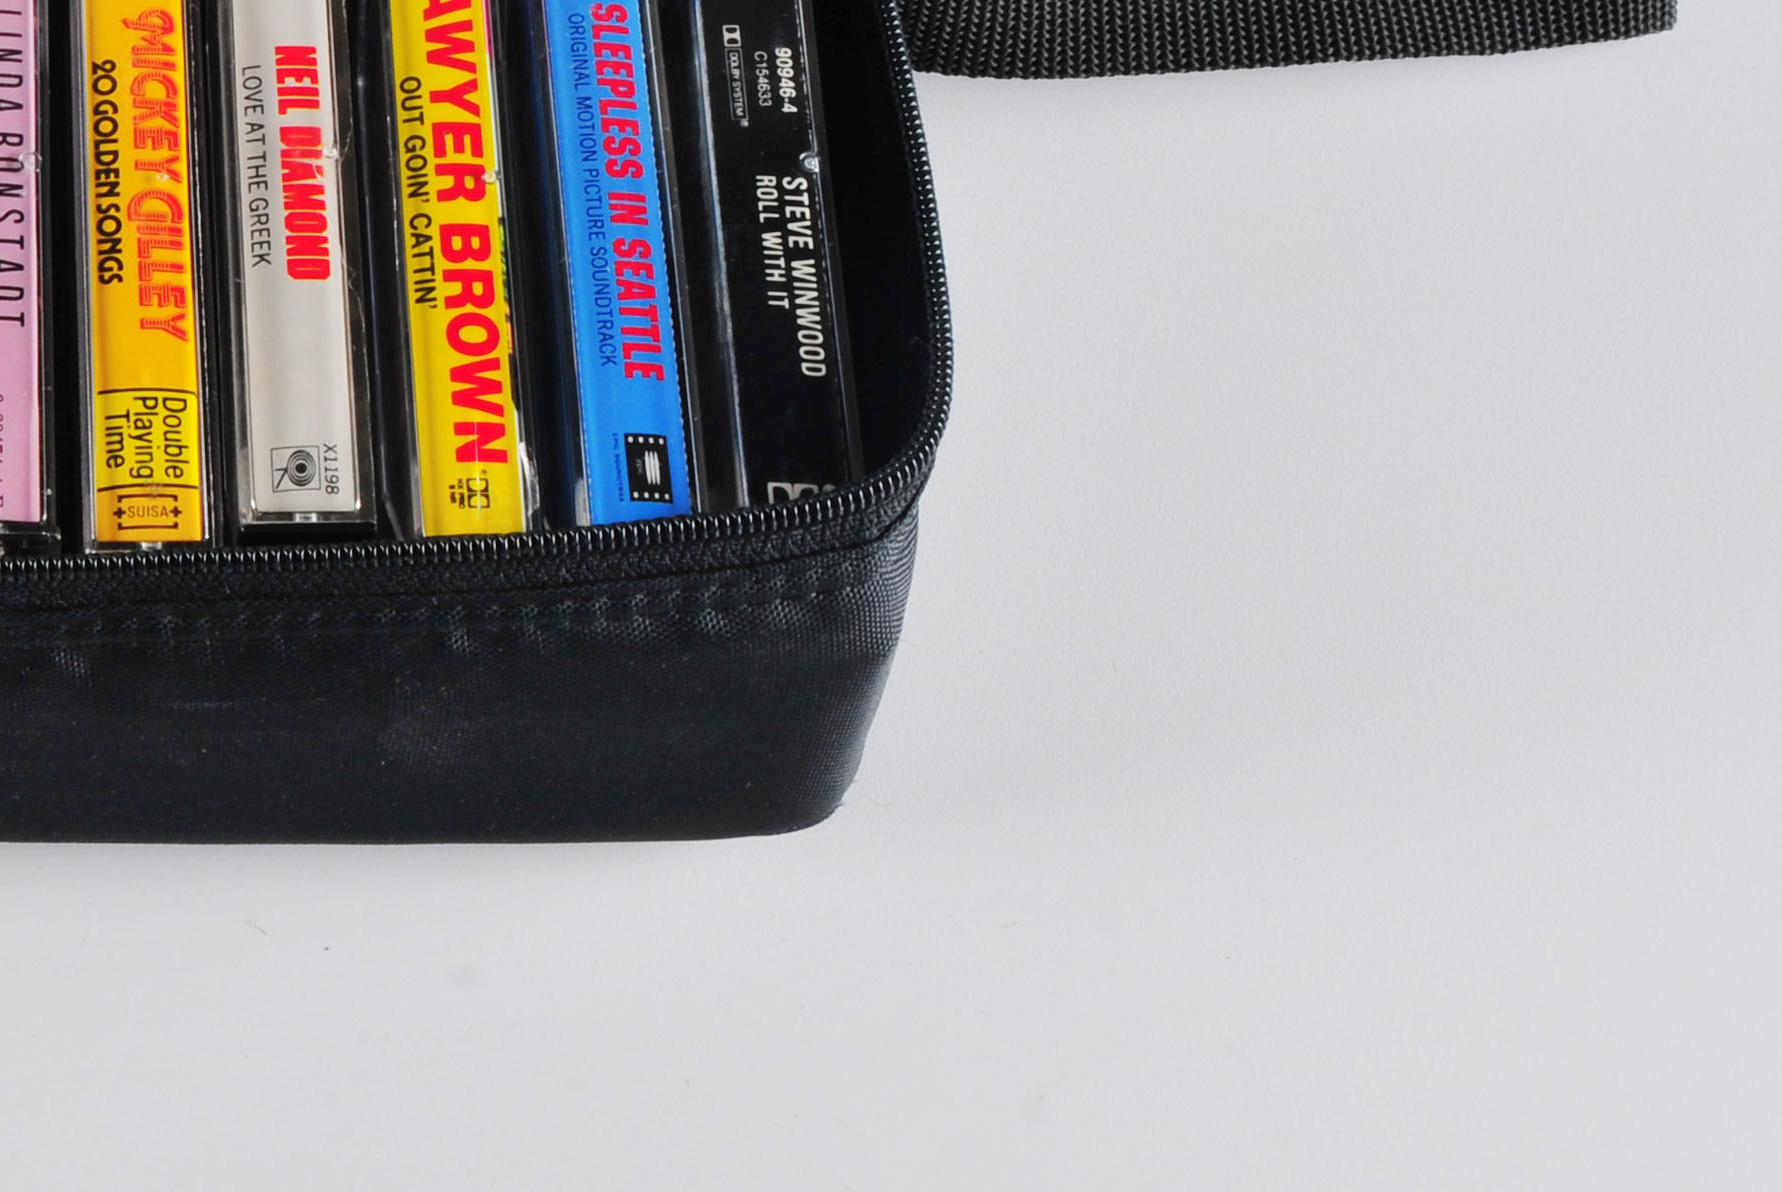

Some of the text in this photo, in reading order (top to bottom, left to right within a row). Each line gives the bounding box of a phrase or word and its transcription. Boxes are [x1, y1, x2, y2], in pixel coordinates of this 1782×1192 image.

[728, 52, 744, 117] DOLBY SYSTEM
[753, 51, 772, 107] C154633
[774, 47, 798, 114] 90946-4
[92, 59, 124, 285] 20 GOLDEN SONGS
[122, 8, 189, 342] MICKEY GILLEY
[241, 64, 272, 268] LOVE AT THE GREEK
[274, 45, 331, 281] NEIL DIAMOND
[399, 76, 438, 309] OUT GOIN' CATTIN'
[568, 12, 618, 368] ORIGINAL MOTION PICTURE SOUNDTRACK
[589, 2, 665, 382] SLEEPLESS IN SEATTLE
[755, 175, 789, 309] ROLL WITH IT
[438, 223, 508, 464] BROWN
[782, 176, 826, 377] STEVE WINWOOD
[104, 408, 130, 469] Time
[127, 504, 169, 518] SUISA
[129, 396, 159, 479] Playing
[161, 396, 189, 479] Double
[323, 443, 340, 495] X1198
